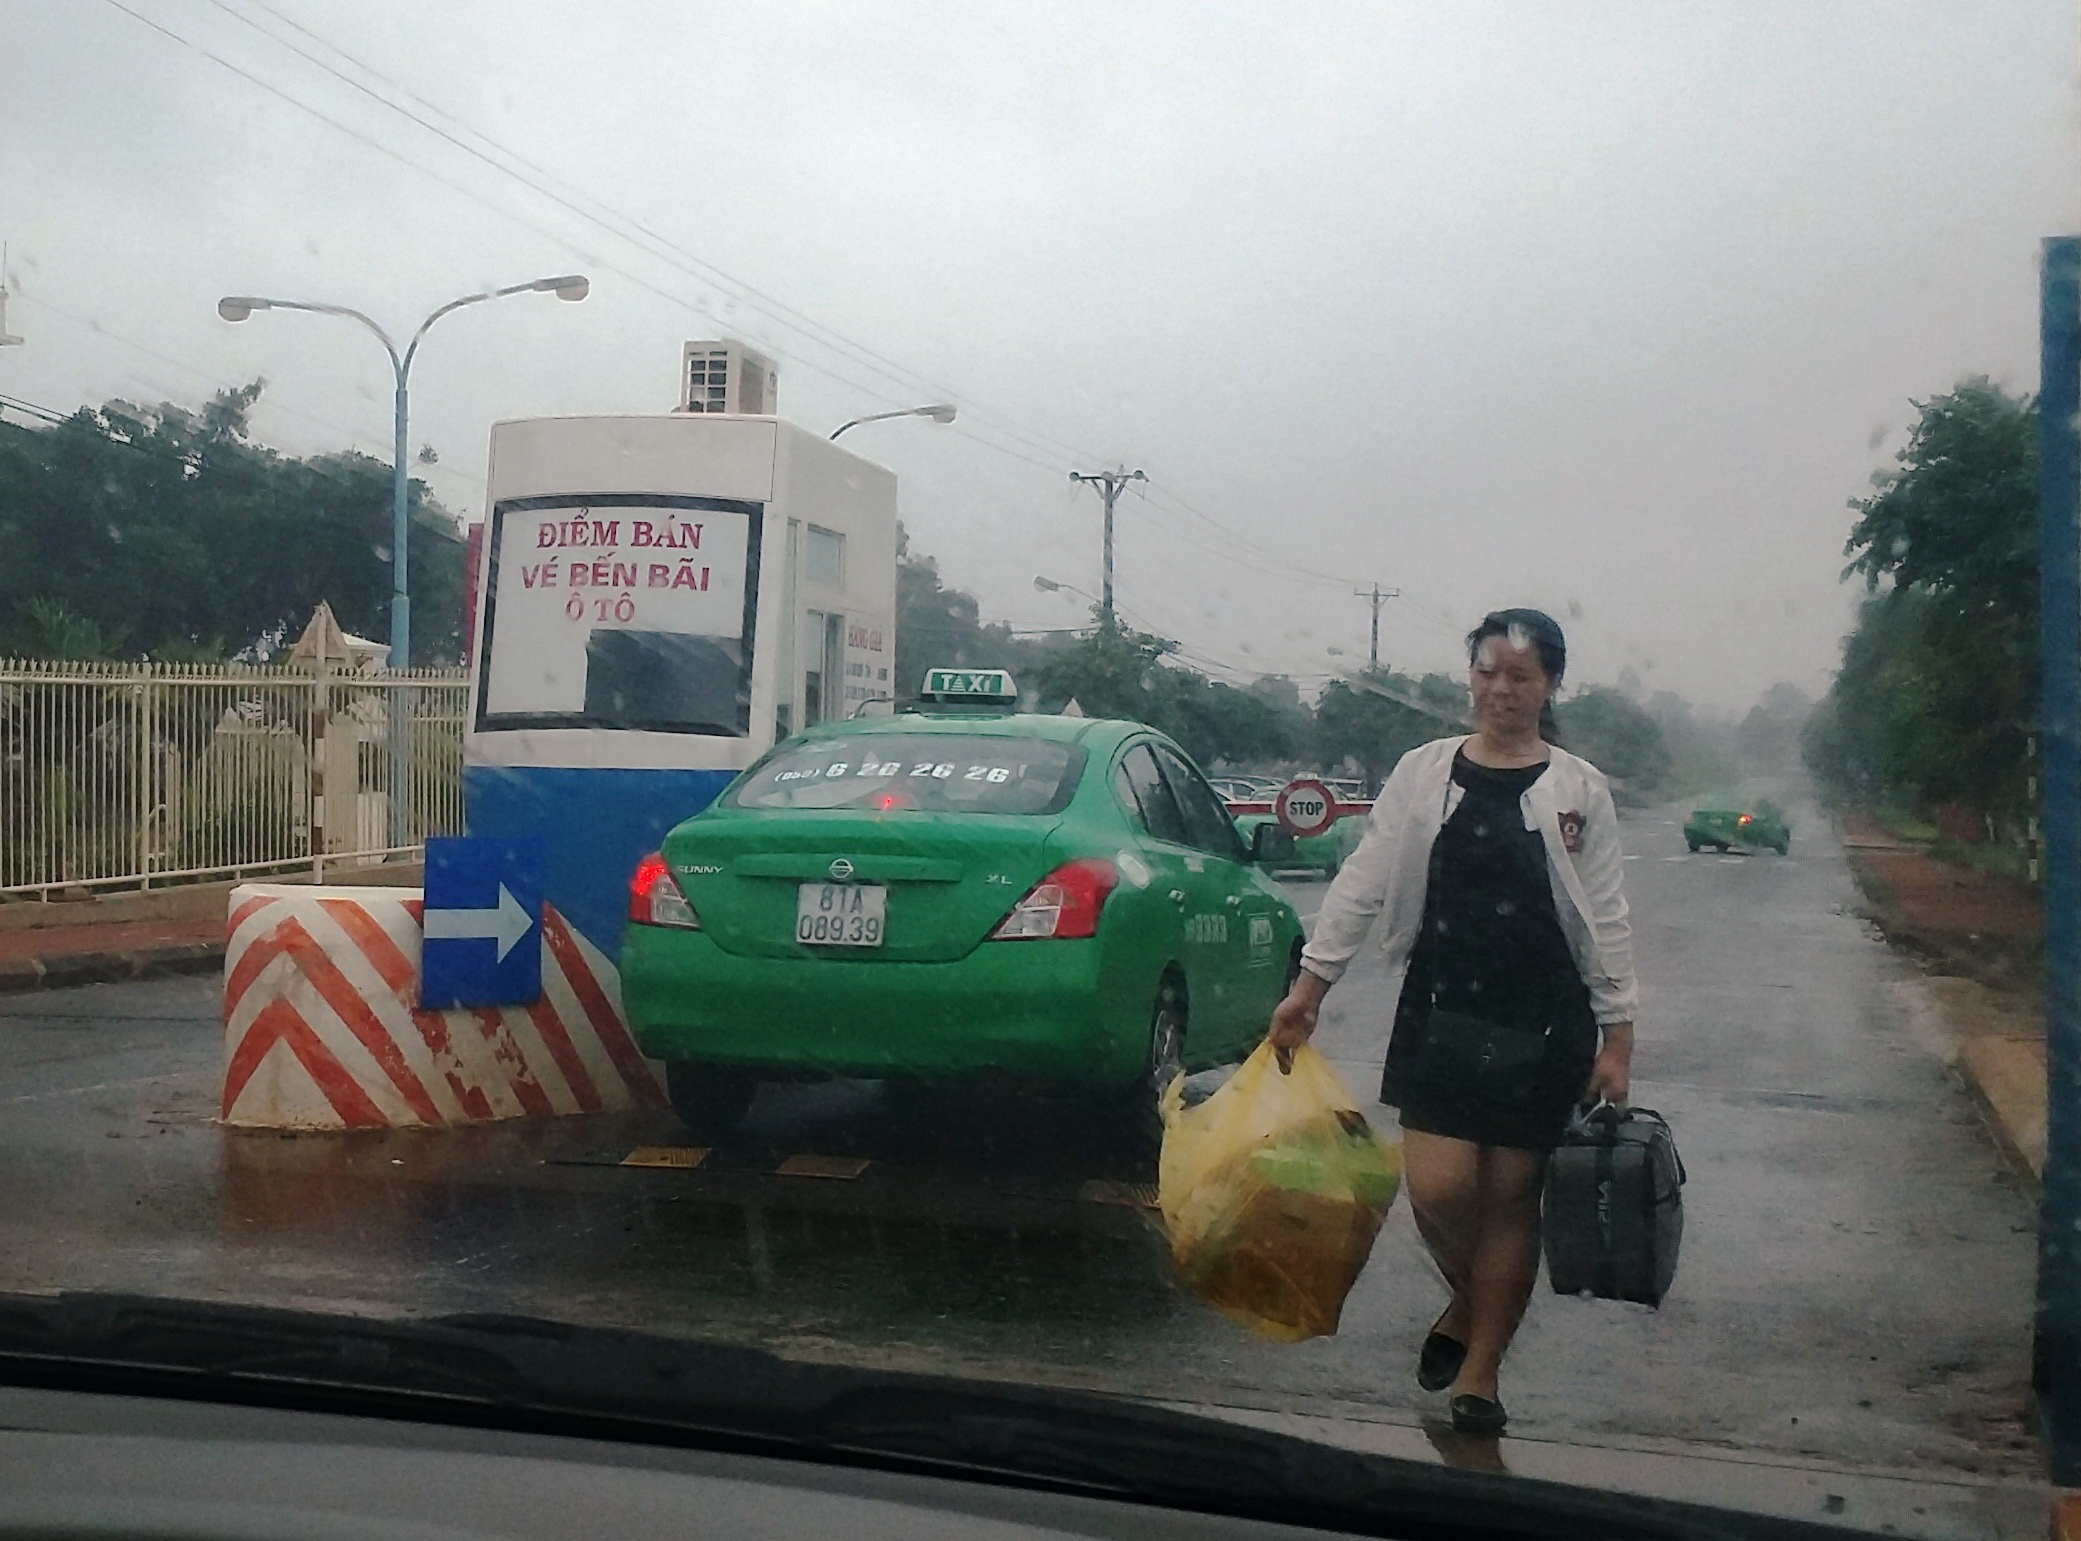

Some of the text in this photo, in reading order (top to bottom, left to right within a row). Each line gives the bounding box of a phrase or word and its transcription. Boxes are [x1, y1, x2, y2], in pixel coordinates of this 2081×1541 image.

[537, 506, 620, 548] ĐIỂM
[521, 552, 710, 591] VÉ BẾN BÃI
[565, 591, 635, 622] Ô TÔ
[825, 763, 849, 778] 6
[856, 762, 901, 777] 26
[909, 763, 955, 779] 26
[964, 765, 1010, 783] 26
[1289, 801, 1324, 816] STOP
[677, 865, 723, 874] SUNNY
[819, 885, 864, 914] 81A
[798, 914, 880, 943] 089.39
